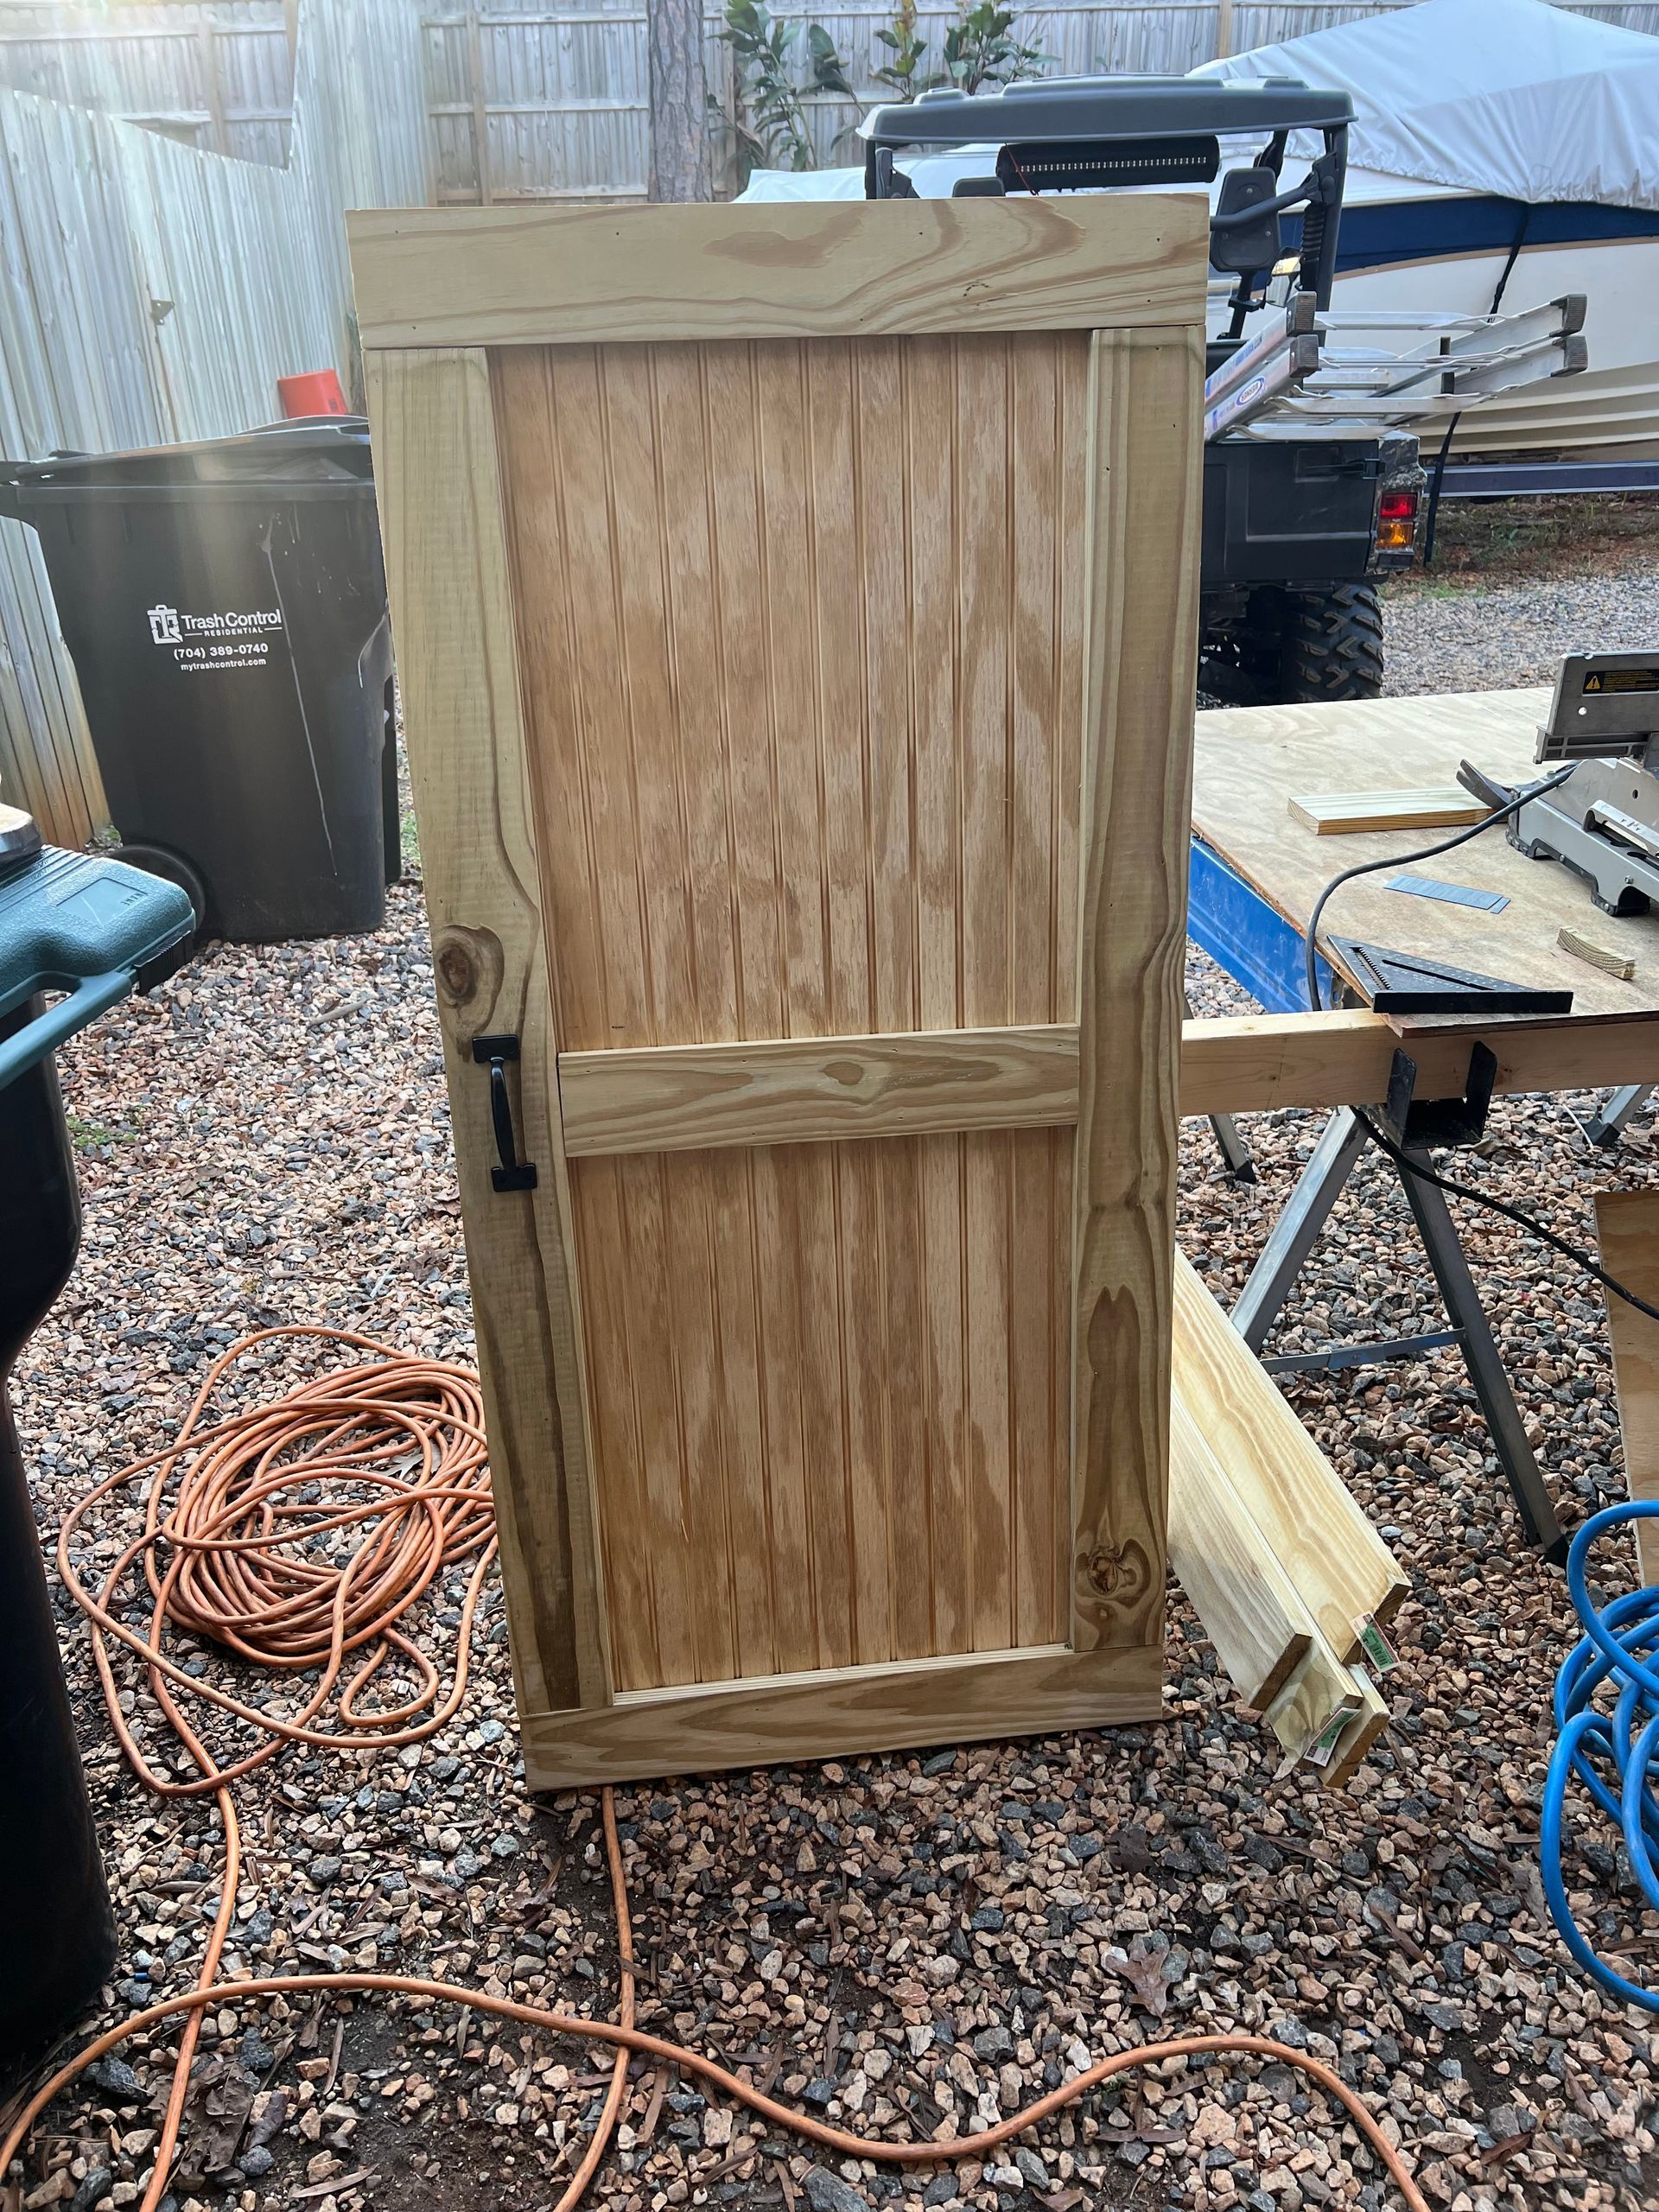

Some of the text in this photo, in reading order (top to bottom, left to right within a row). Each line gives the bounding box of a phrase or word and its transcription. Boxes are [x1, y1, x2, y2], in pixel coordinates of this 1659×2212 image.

[181, 608, 282, 630] Trash Control
[204, 626, 263, 637] RESIDENTIAL
[174, 642, 269, 660] (704) 389-0740
[181, 658, 267, 671] mytrashcontrol.com
